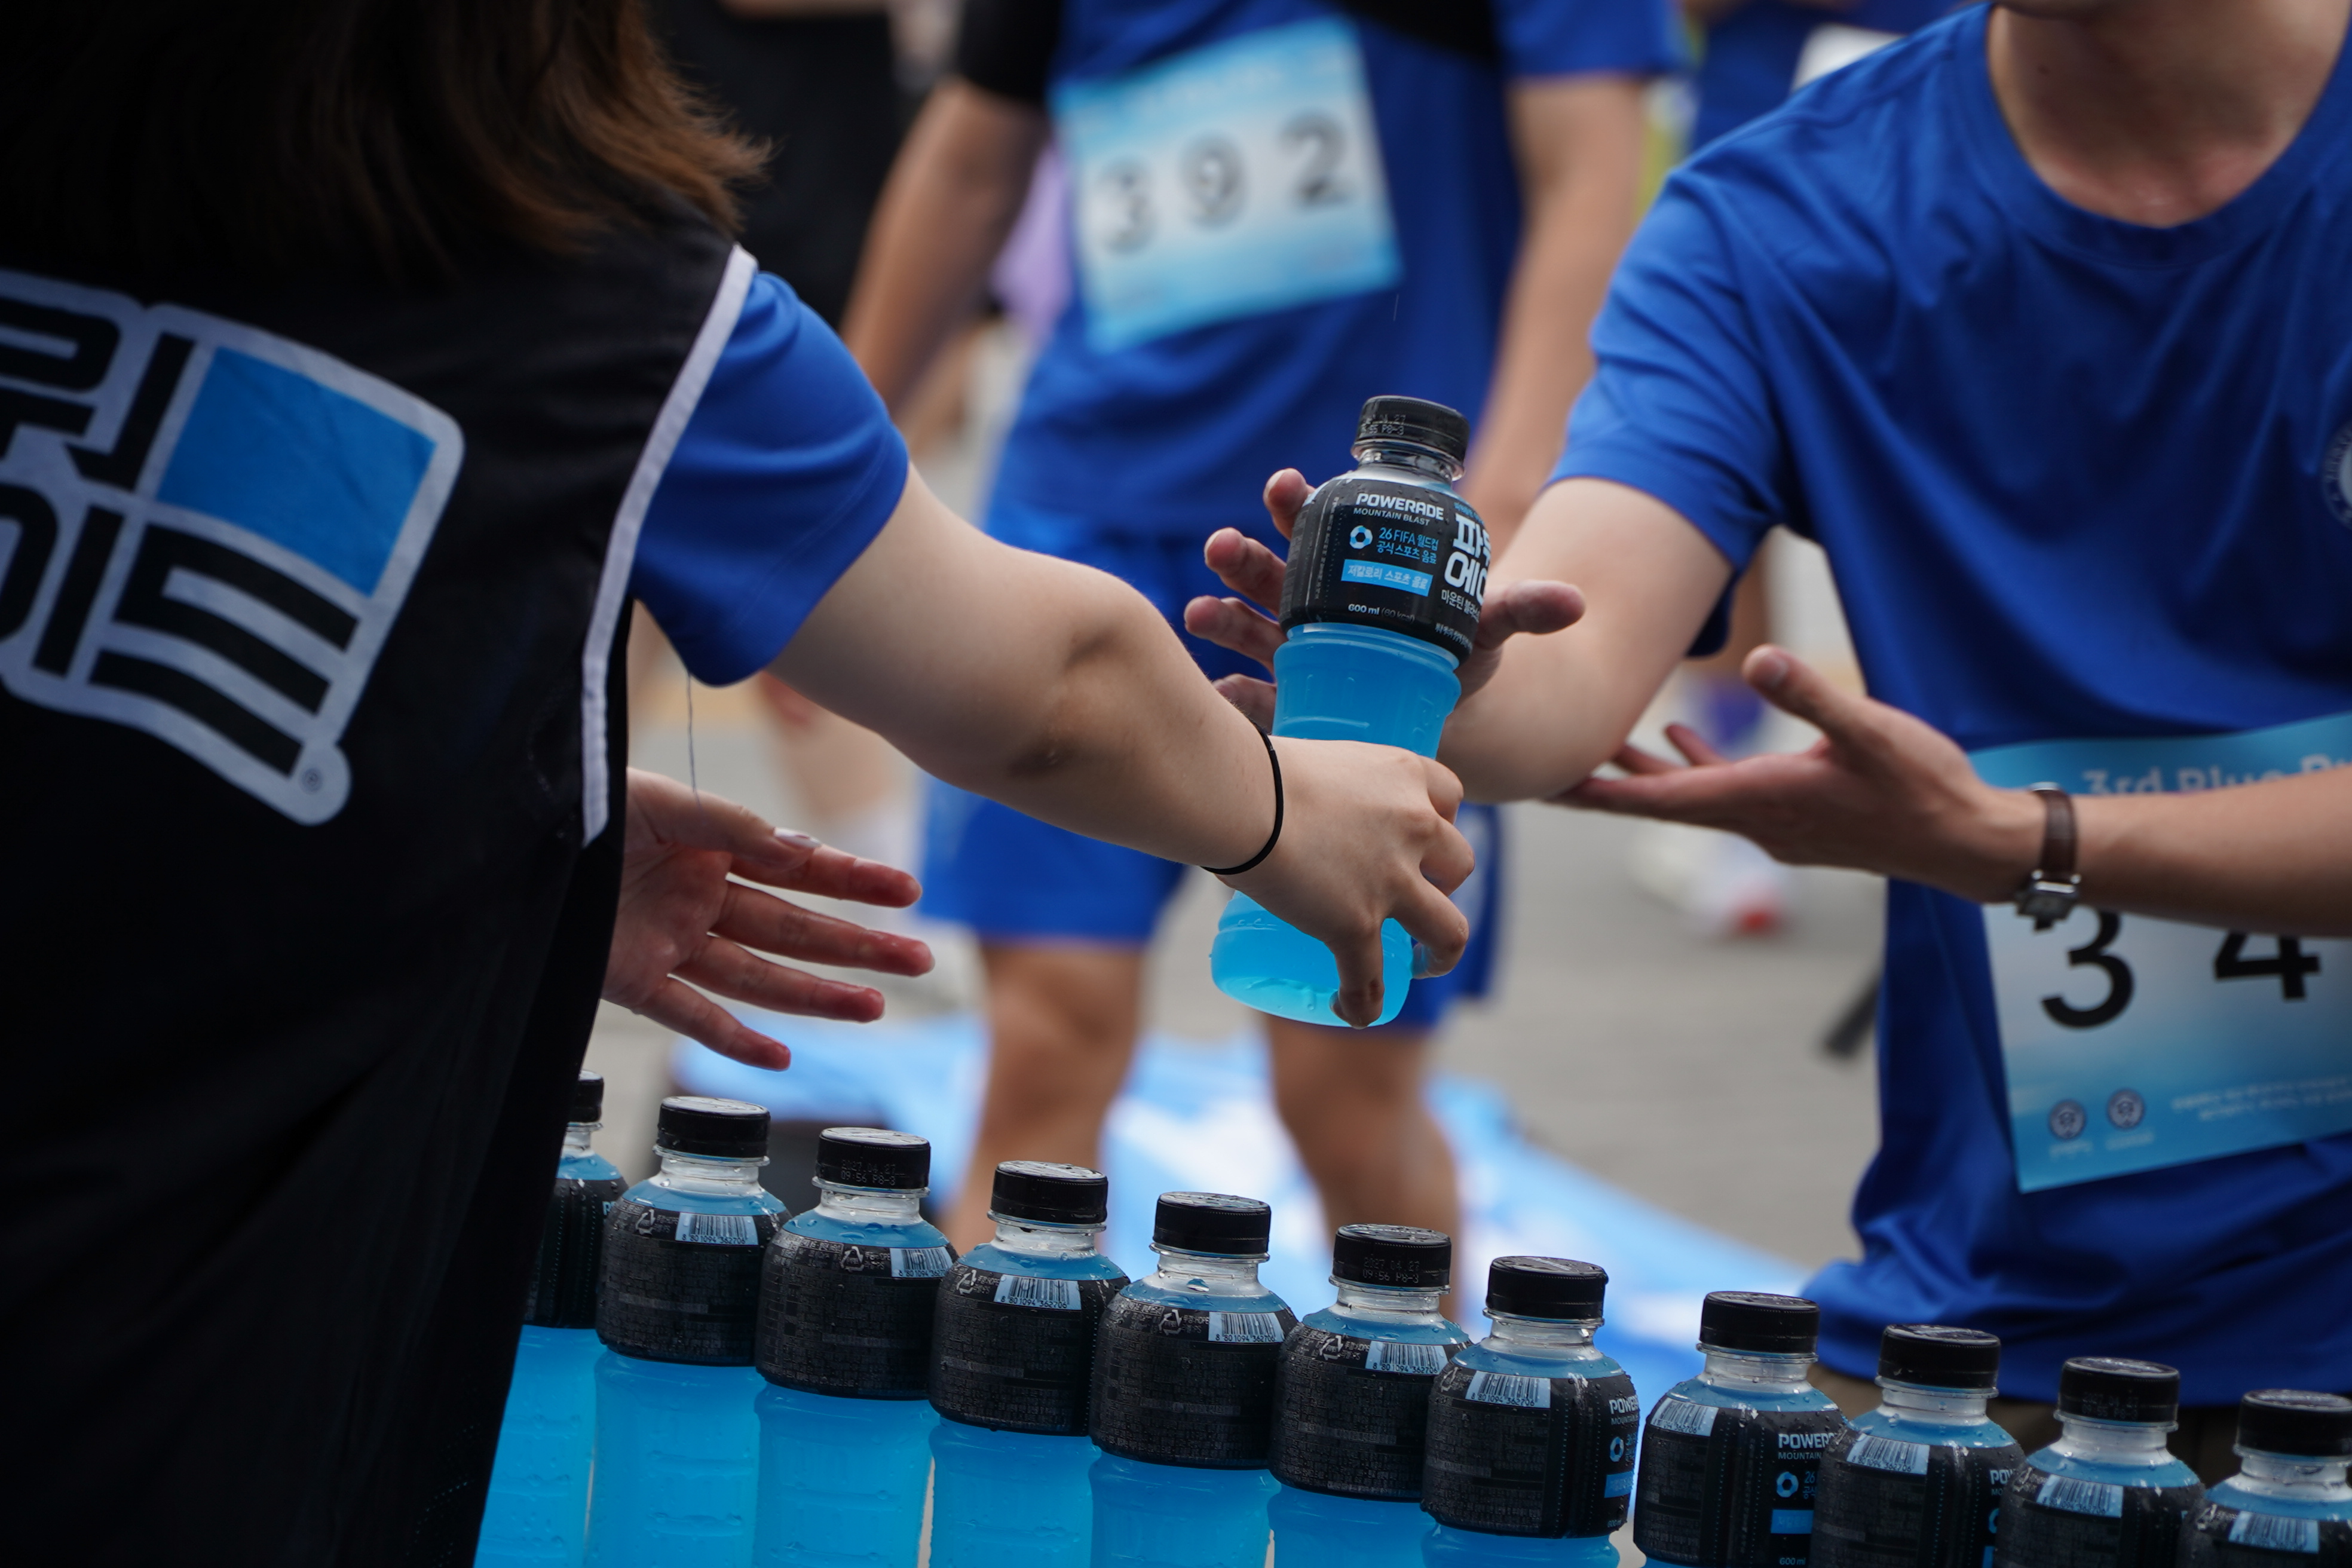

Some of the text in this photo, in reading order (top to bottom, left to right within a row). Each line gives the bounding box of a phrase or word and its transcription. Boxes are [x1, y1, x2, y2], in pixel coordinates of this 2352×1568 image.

[1097, 109, 1354, 255] 392
[1355, 492, 1444, 521] POWERADE
[1353, 507, 1431, 526] MOUNTAIN BLAST
[1379, 526, 1440, 552] 26 FIFA 월드컵
[1376, 540, 1437, 565] 공식 스포츠 음료
[1348, 564, 1429, 590] 저칼로리 스포츠 음료
[1441, 589, 1465, 611] 마운틴
[1348, 603, 1367, 613] 600
[1367, 607, 1380, 615] ml
[840, 1170, 867, 1183] 09:56
[930, 1269, 945, 1278] 3627
[1362, 1269, 1391, 1281] 09:56
[1039, 1299, 1067, 1309] 362706
[1412, 1365, 1438, 1374] 362706
[1506, 1397, 1535, 1407] 362706
[1778, 1451, 1822, 1460] MOUNTAIN
[1884, 1460, 1912, 1472] 362706
[1804, 1471, 1815, 1484] 26
[1780, 1557, 1796, 1566] 600
